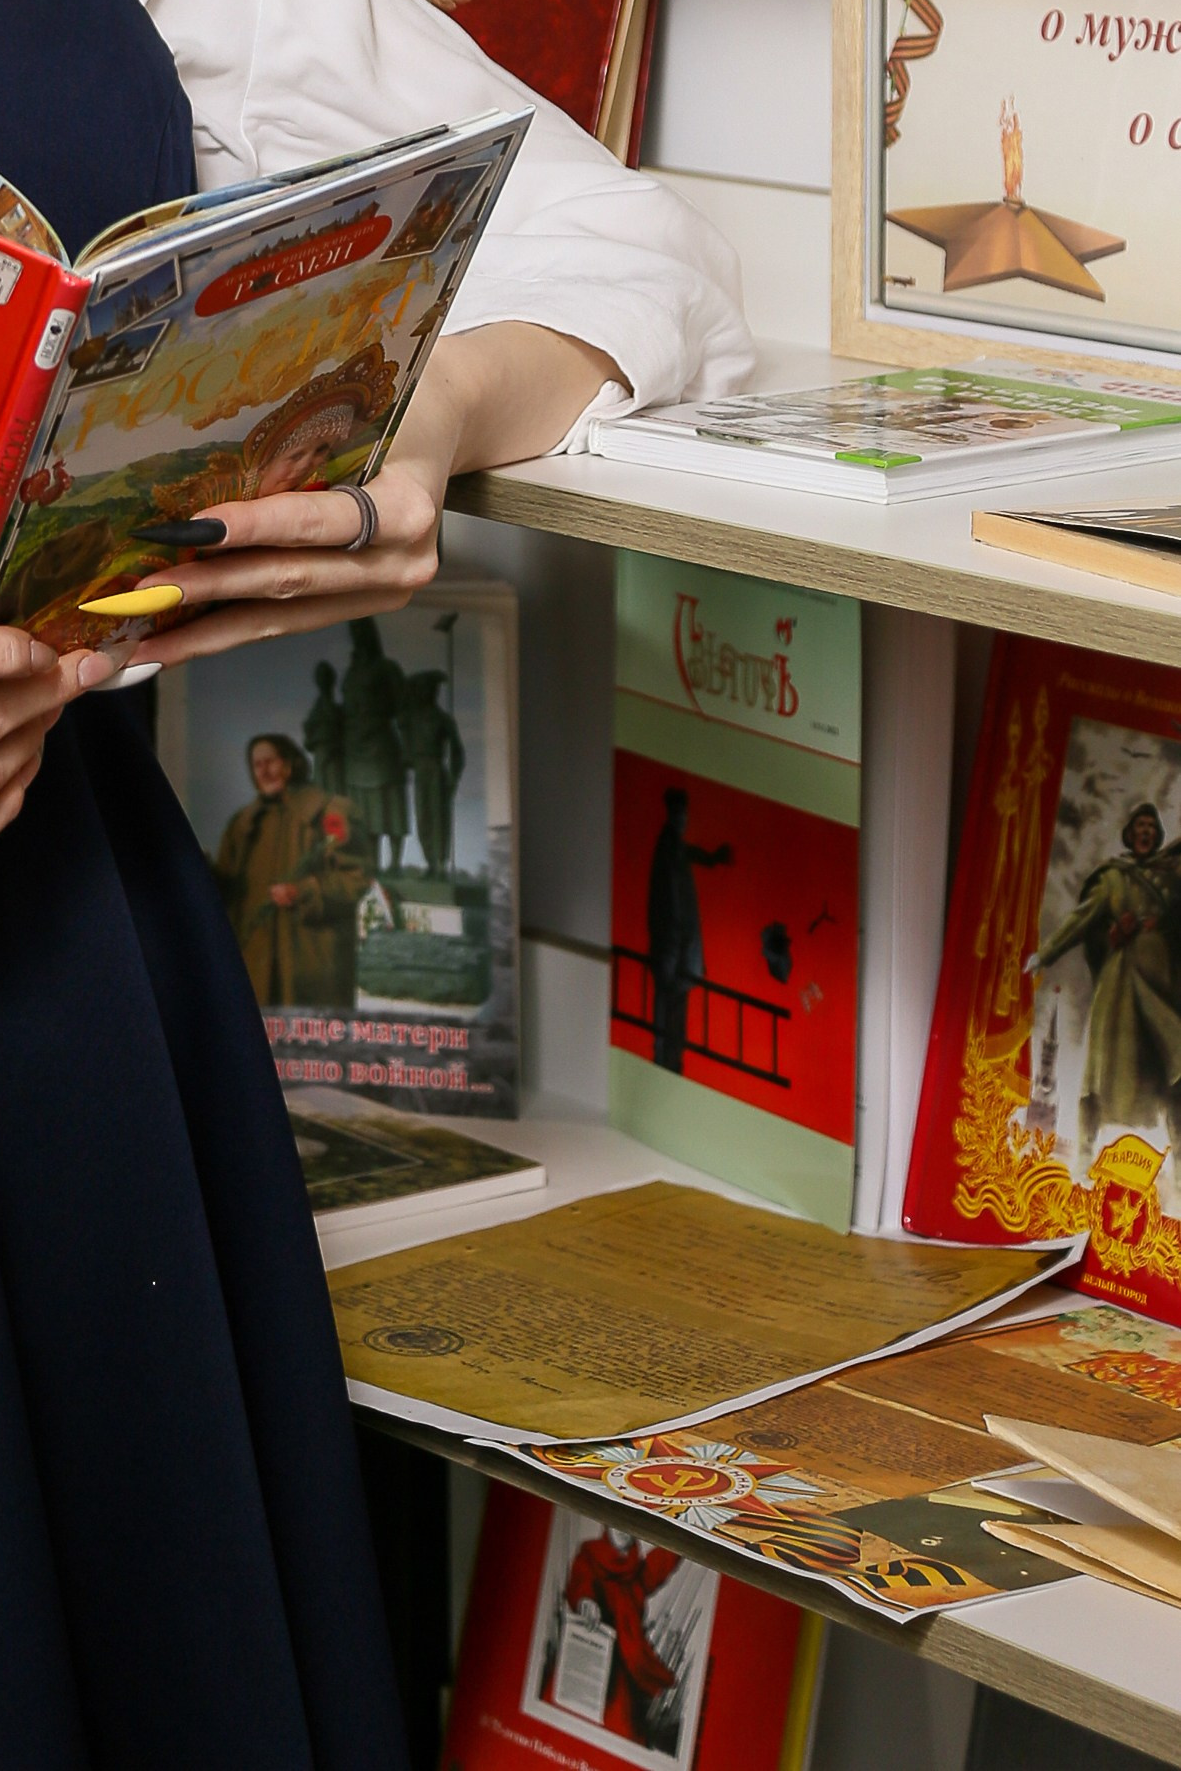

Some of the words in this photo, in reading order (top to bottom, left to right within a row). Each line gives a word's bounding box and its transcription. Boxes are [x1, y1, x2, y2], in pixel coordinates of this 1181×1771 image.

[1040, 8, 1066, 43] о
[1128, 111, 1155, 146] о
[265, 1015, 345, 1047] рдце
[352, 1018, 469, 1054] матери
[1083, 1272, 1117, 1293] БЕЛЫЙ
[1117, 1284, 1148, 1306] ГОРОД
[610, 1457, 751, 1496] ОТЕЧЕСТВЕННАЯ
[643, 1494, 728, 1506] ВОЙНА
